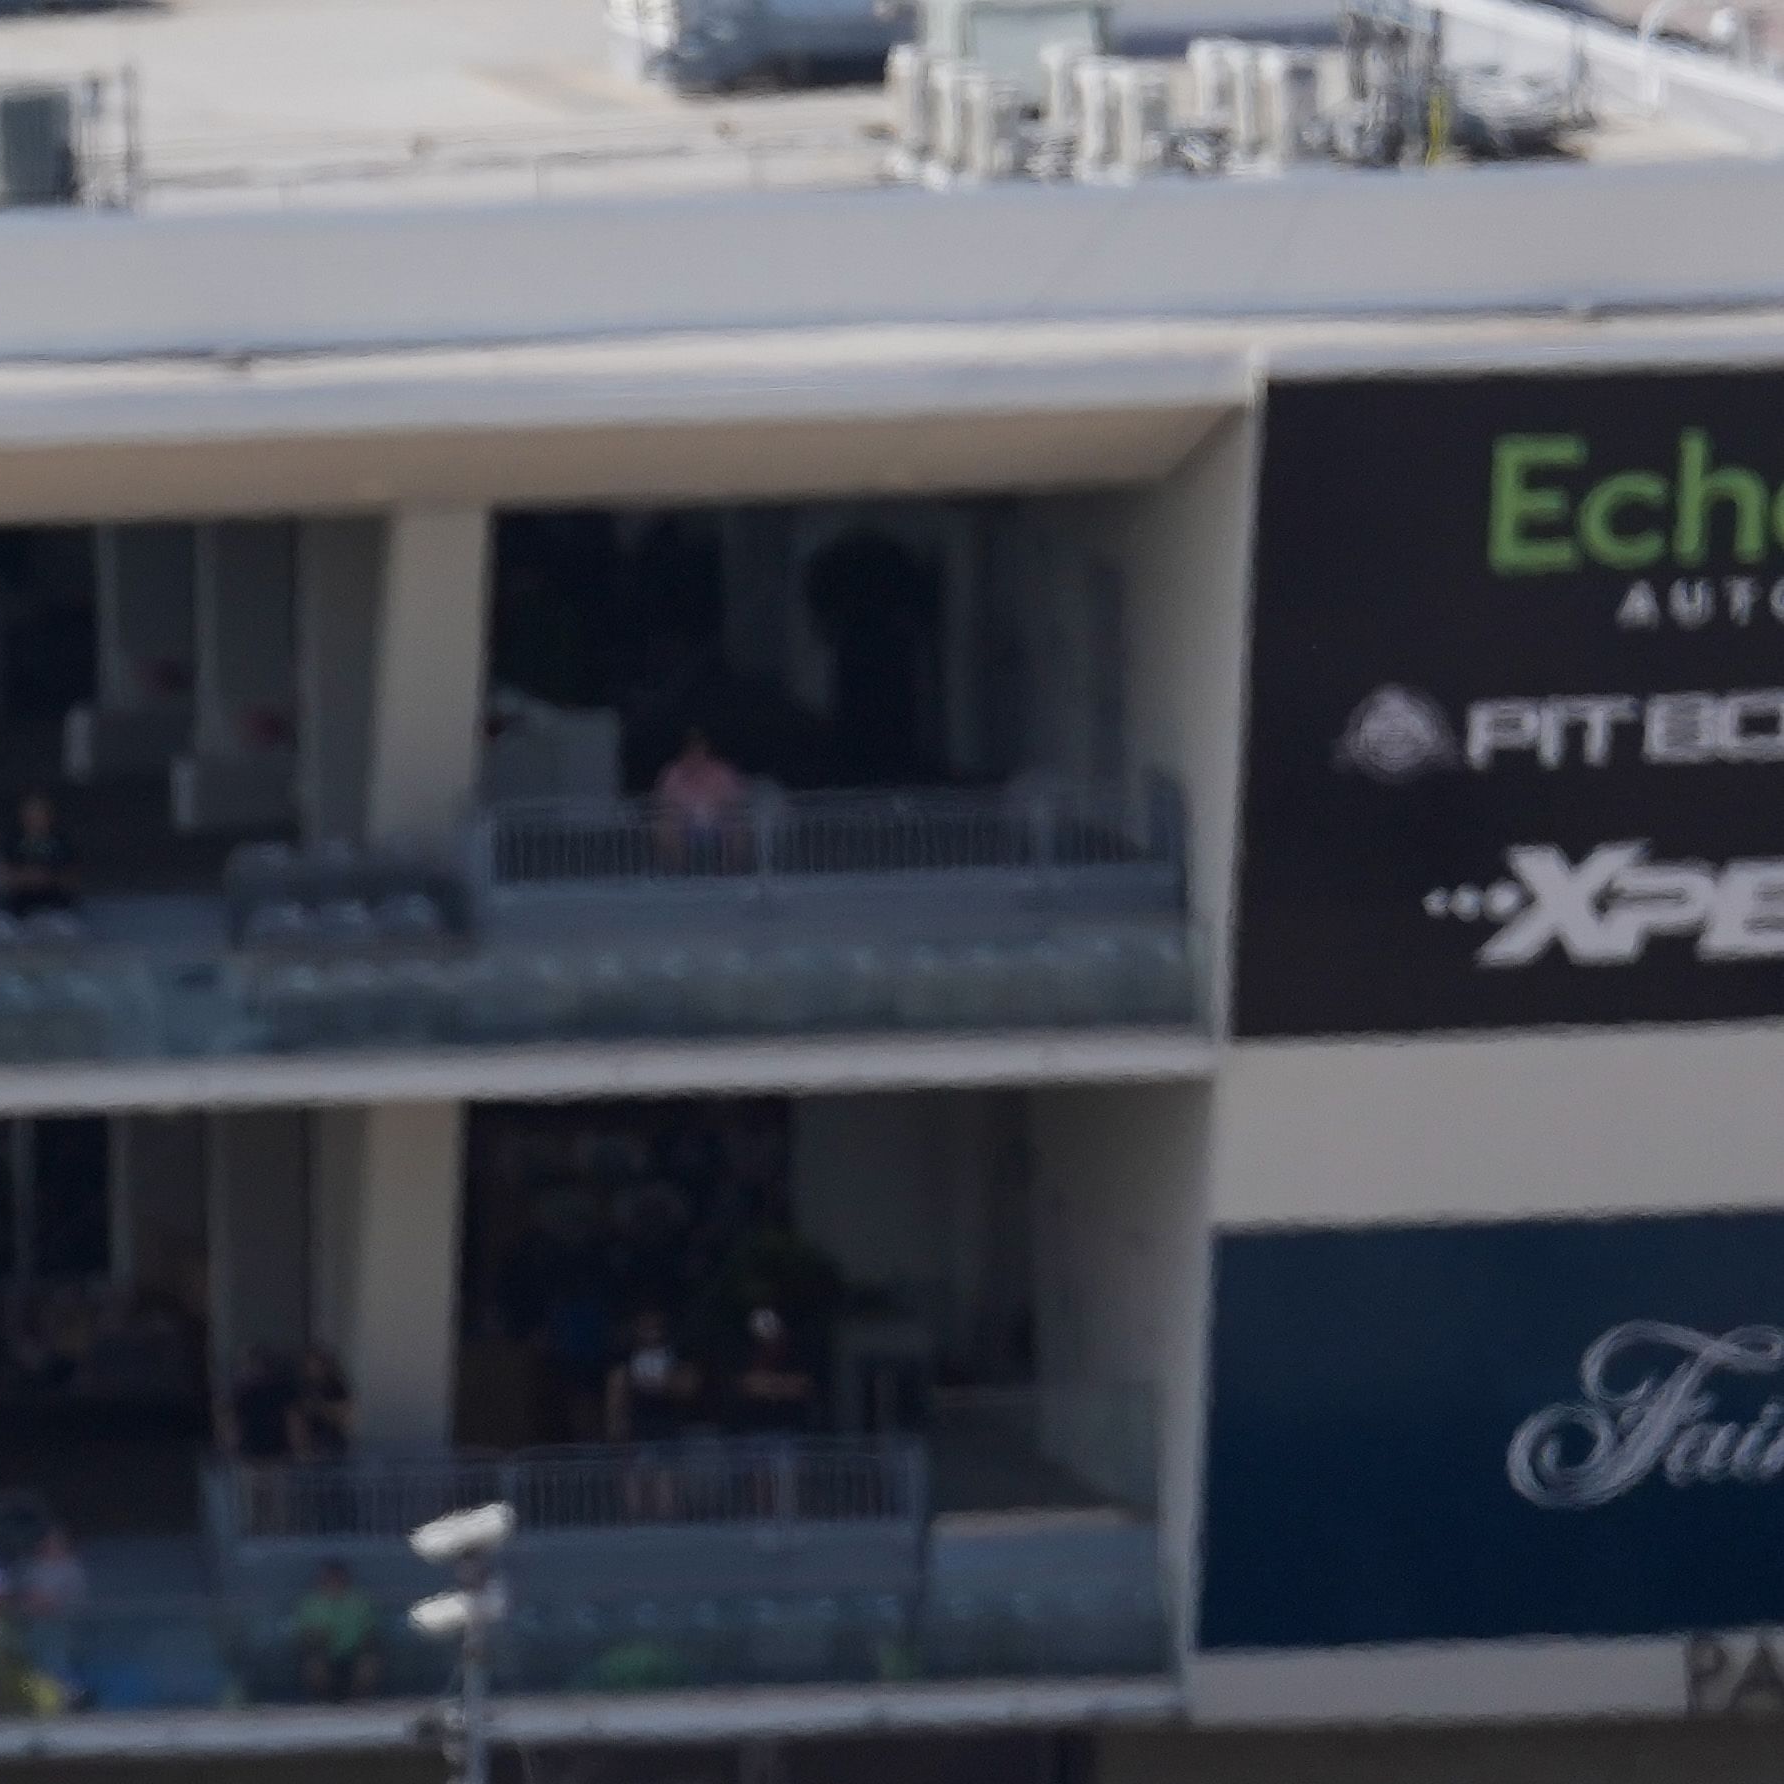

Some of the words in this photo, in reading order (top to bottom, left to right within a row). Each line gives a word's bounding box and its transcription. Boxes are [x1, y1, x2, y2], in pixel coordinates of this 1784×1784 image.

[1488, 428, 1784, 572] Ech
[1466, 697, 1640, 767] PIT
[1506, 1320, 1784, 1508] Fai
